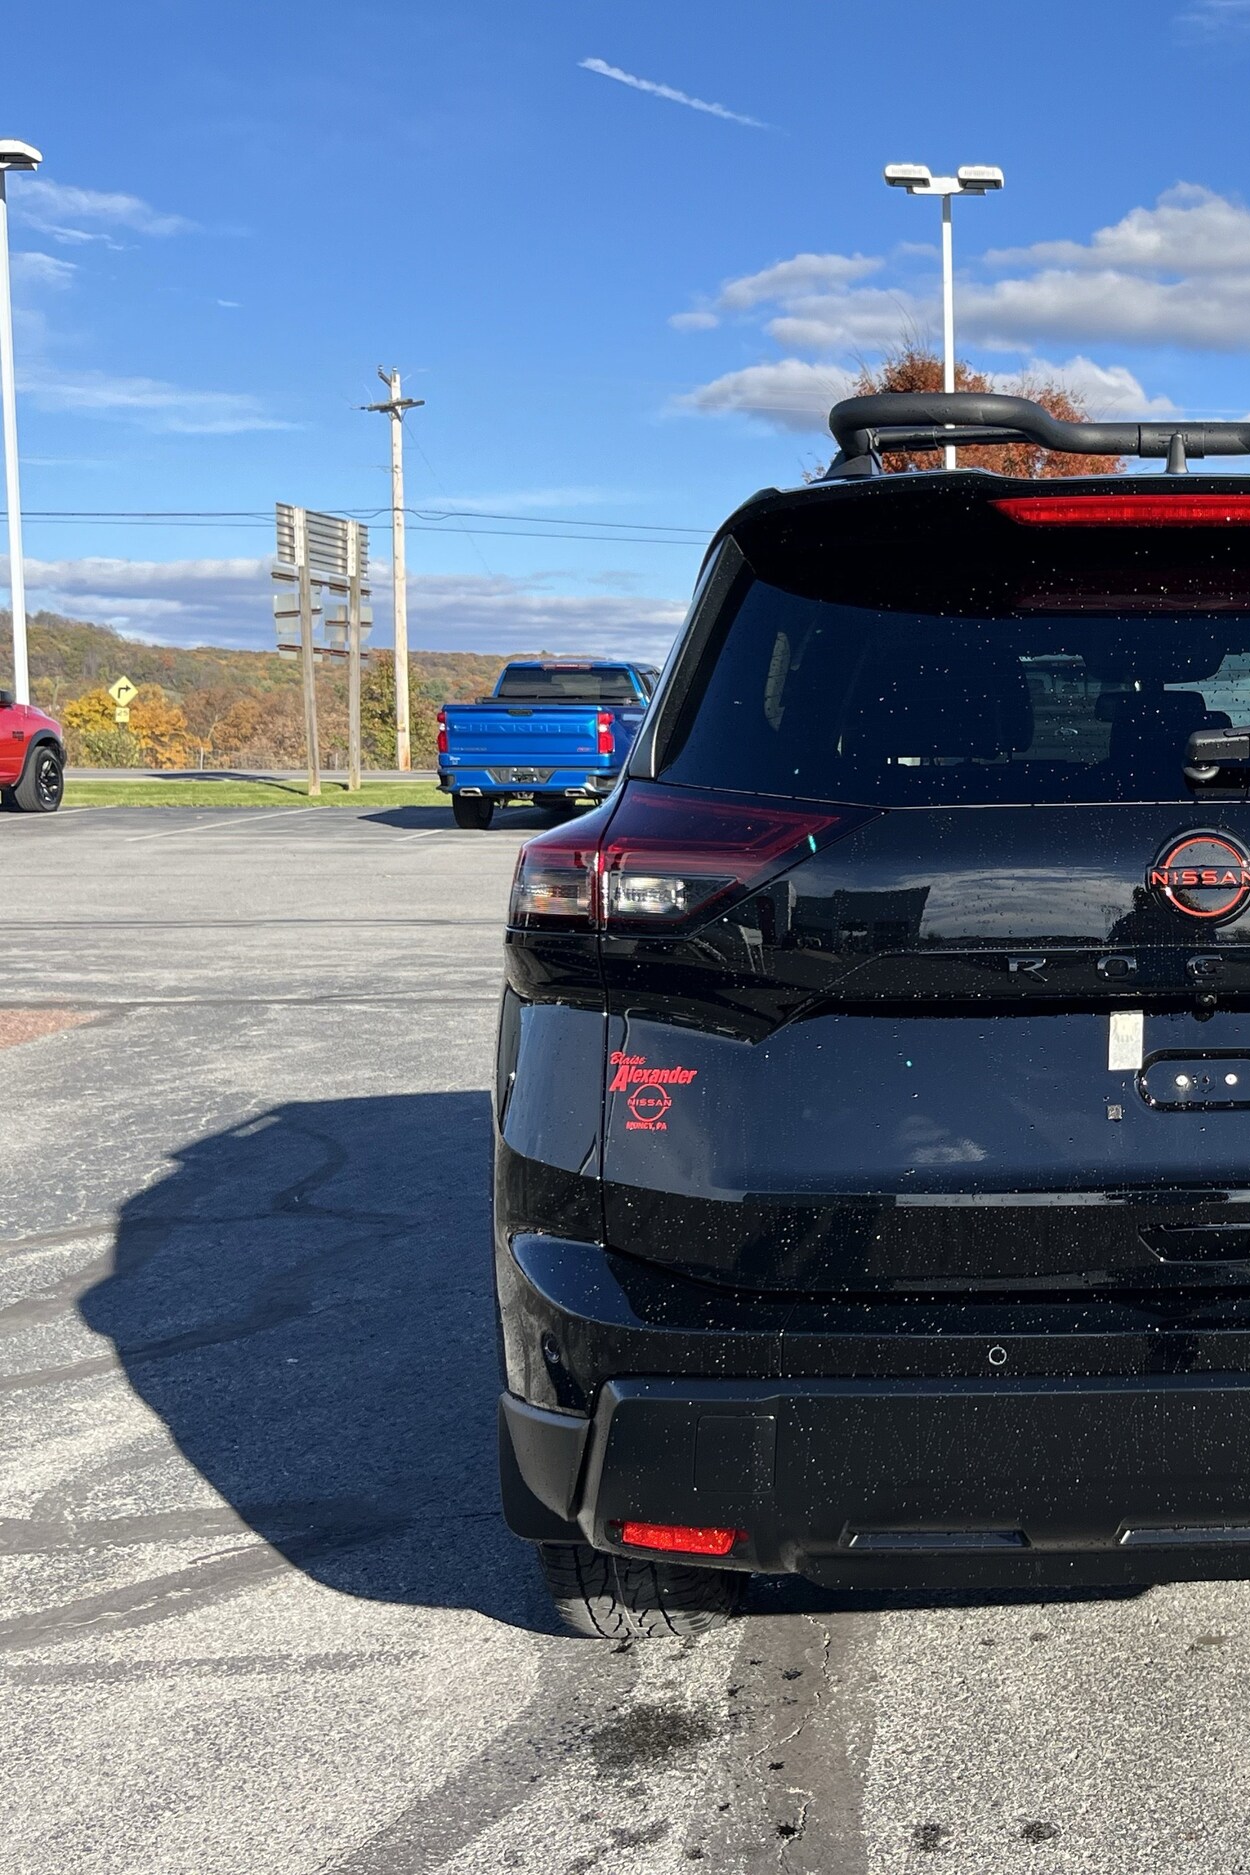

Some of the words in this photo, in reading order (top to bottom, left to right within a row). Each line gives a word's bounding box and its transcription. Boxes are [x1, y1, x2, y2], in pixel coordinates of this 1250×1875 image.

[608, 1065, 698, 1092] Alexander
[627, 1098, 672, 1107] NISSAN
[656, 1121, 667, 1130] PA
